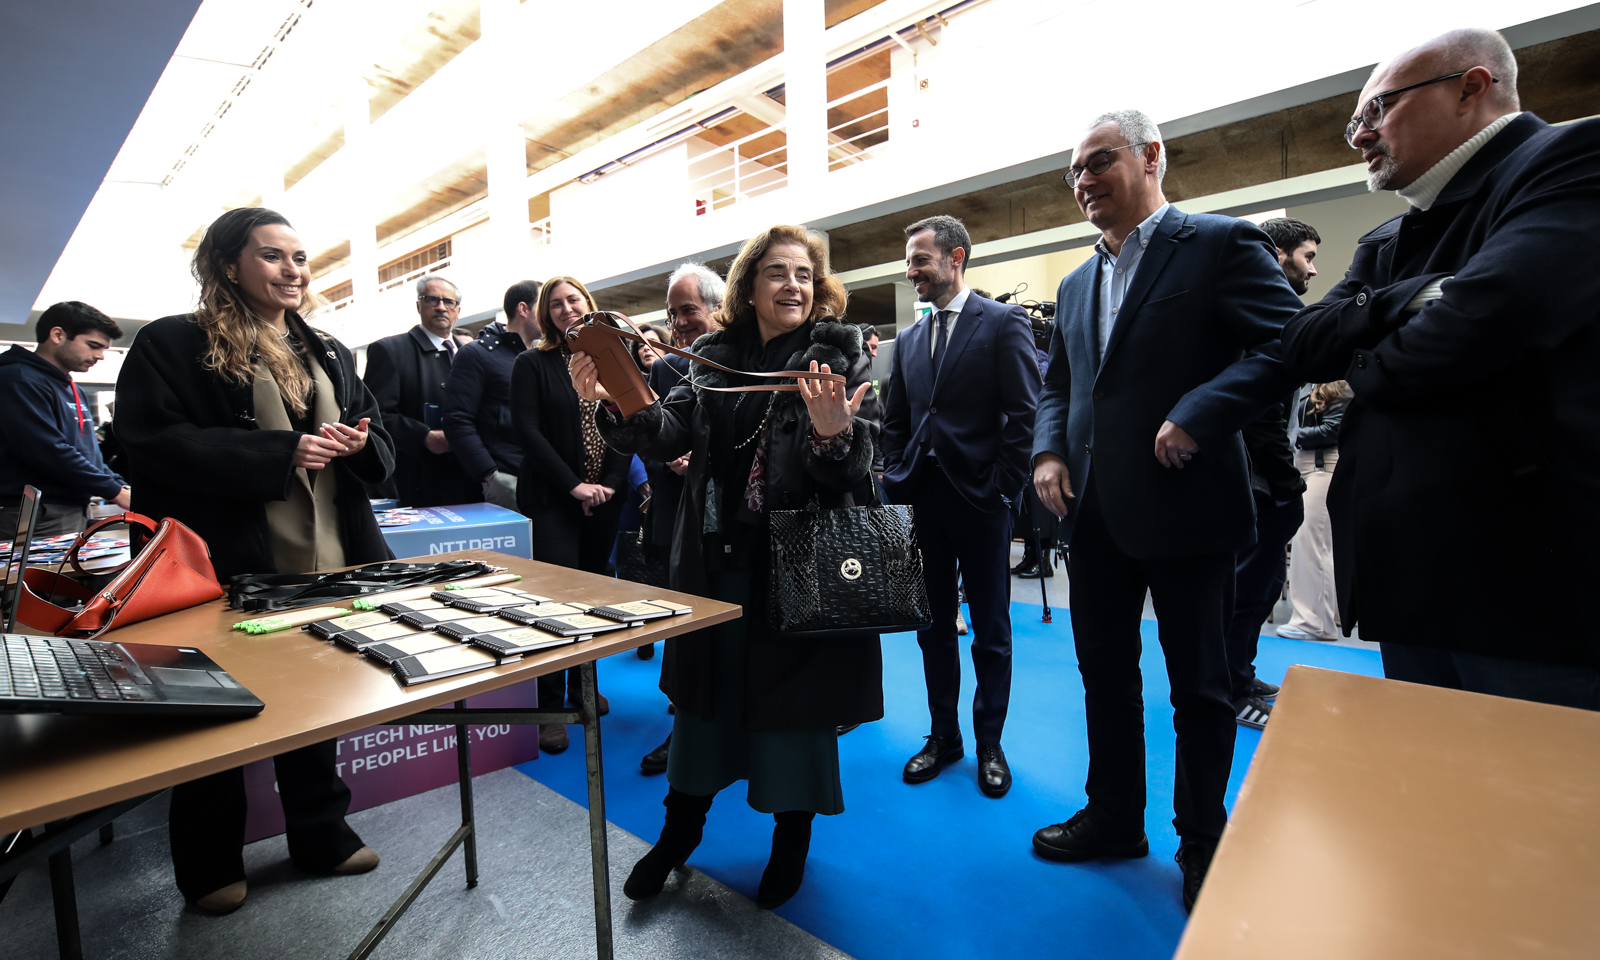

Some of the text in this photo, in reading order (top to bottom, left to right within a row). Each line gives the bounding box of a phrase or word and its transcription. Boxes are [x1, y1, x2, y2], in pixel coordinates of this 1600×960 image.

[430, 540, 467, 555] NTT
[350, 727, 404, 752] TECH
[352, 742, 428, 775] PEOPLE
[433, 730, 472, 753] LIK
[475, 724, 511, 741] YOU
